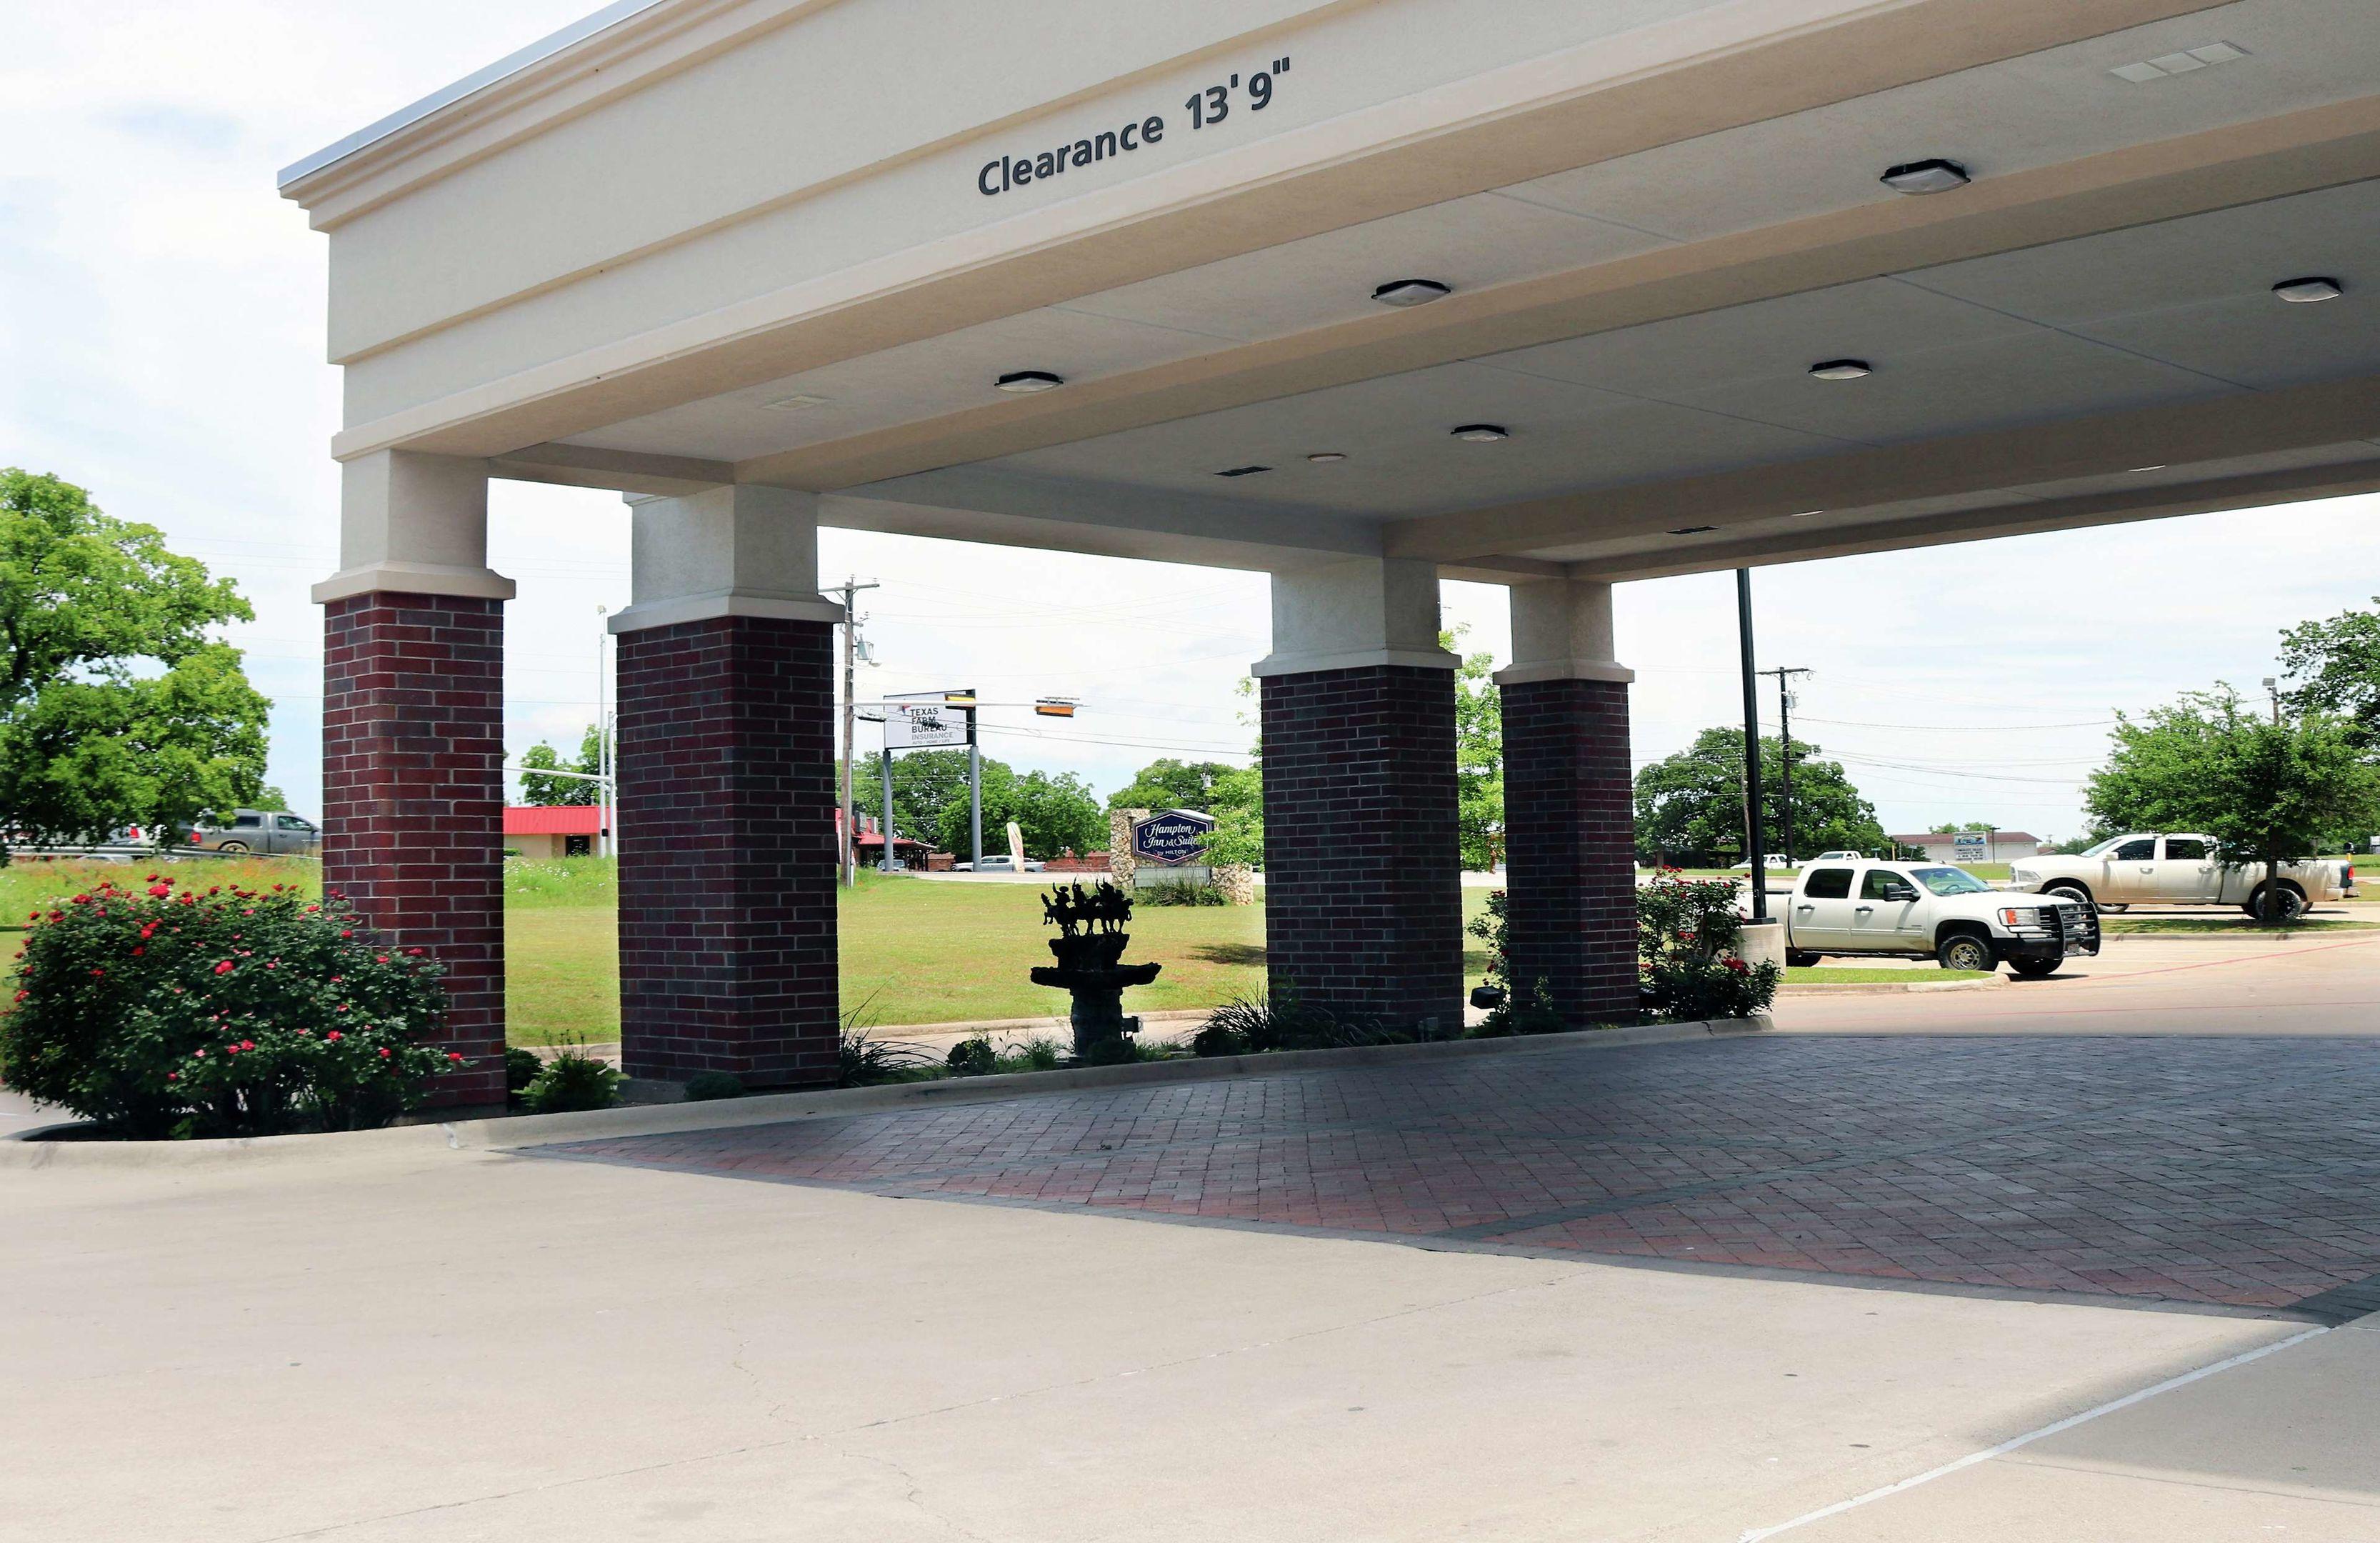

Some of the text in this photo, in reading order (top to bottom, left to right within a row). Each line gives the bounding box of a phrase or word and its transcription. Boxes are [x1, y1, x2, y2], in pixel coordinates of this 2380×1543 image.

[978, 116, 1164, 196] Clearance
[910, 707, 939, 716] TEXAS
[911, 731, 953, 740] INSURANCE
[1145, 824, 1196, 837] Hampton
